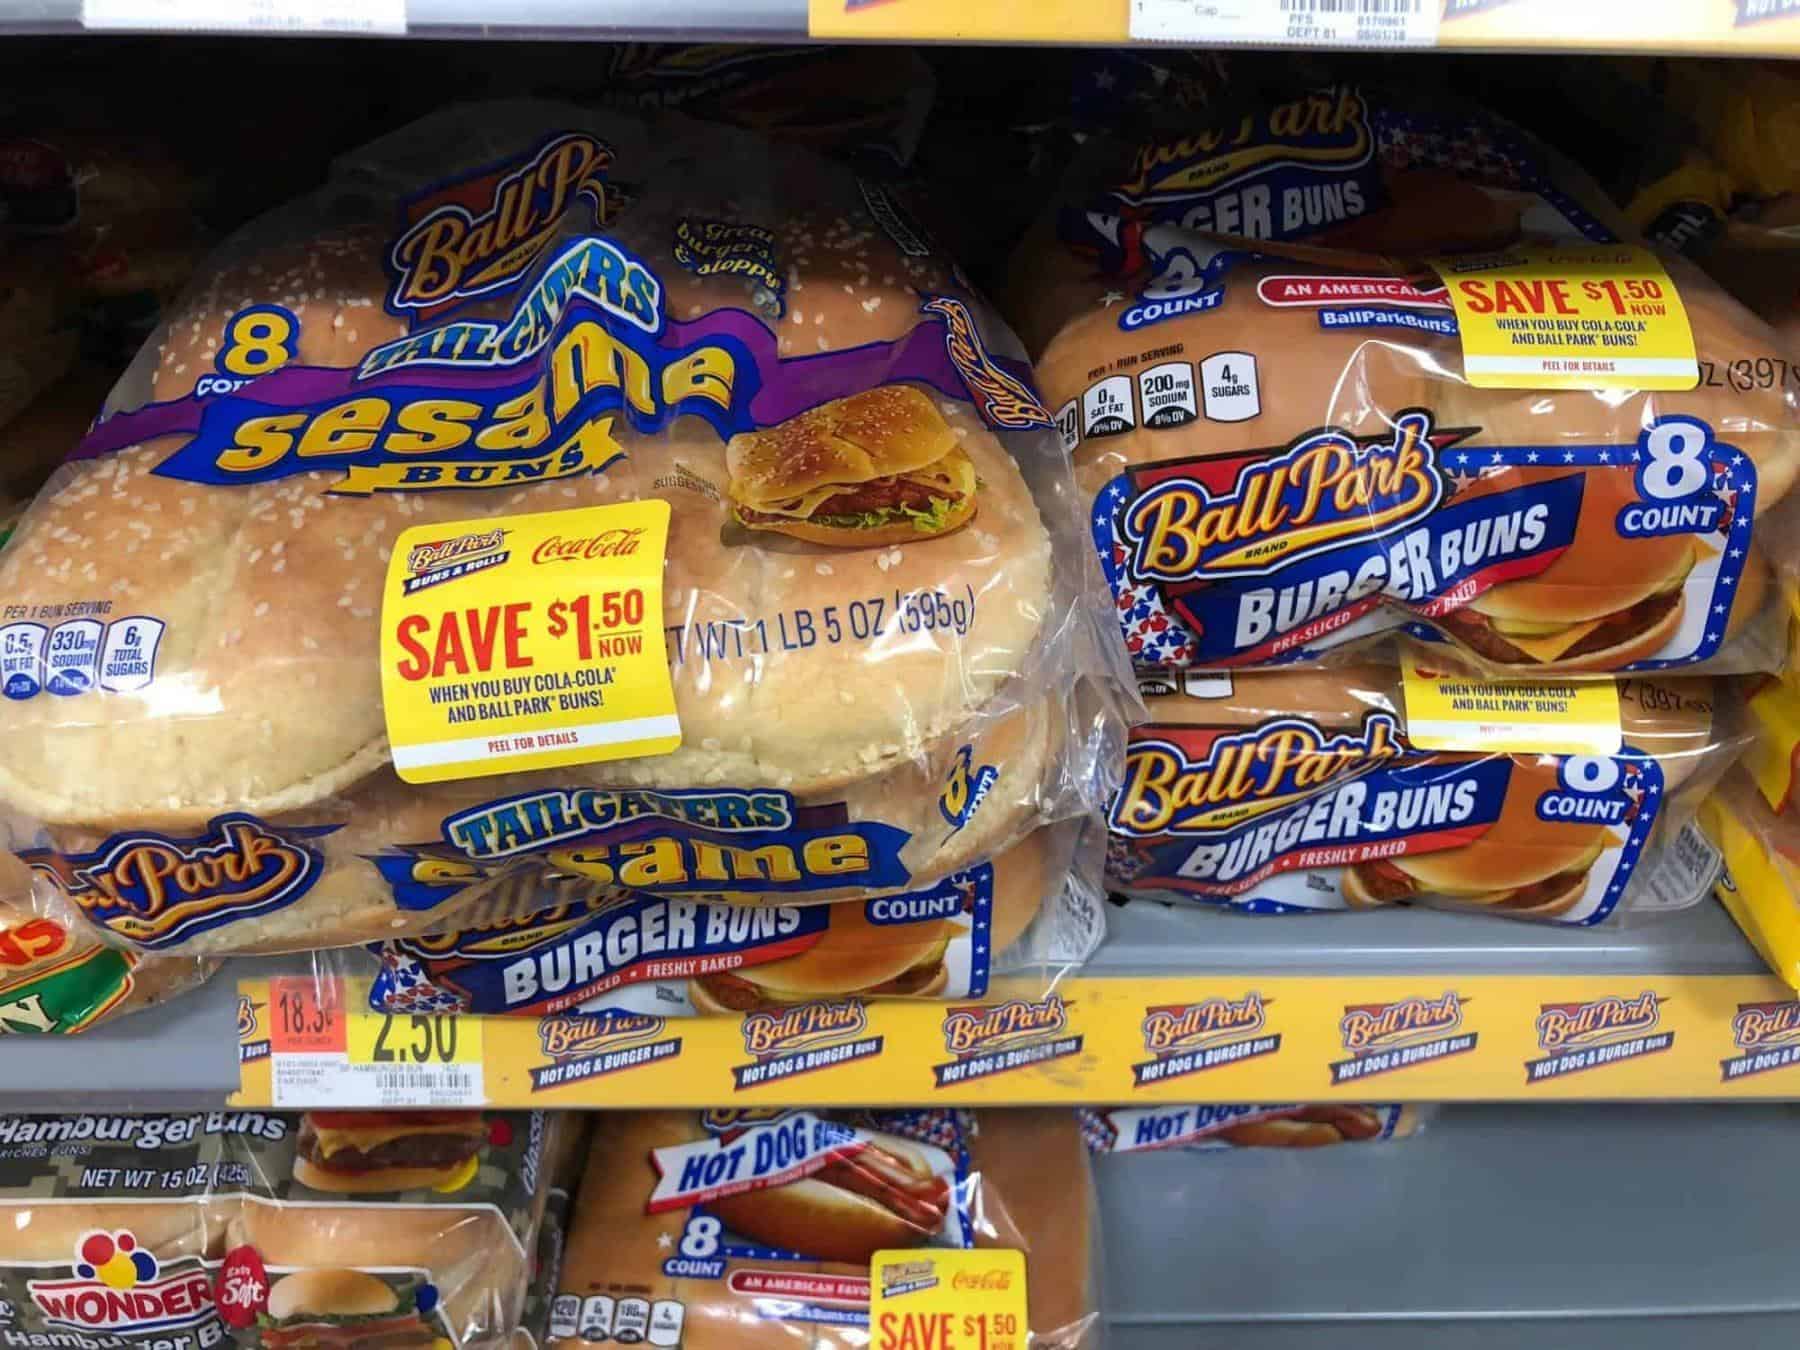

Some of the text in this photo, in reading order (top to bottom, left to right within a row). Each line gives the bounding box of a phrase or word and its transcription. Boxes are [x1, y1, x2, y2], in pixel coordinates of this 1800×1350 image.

[1283, 180, 1366, 232] BUNS
[403, 171, 540, 299] Ball
[697, 258, 783, 289] sloppy
[1284, 284, 1311, 296] AN
[1125, 291, 1220, 327] COUNT
[1459, 279, 1664, 316] SAVE $1.50
[1630, 304, 1667, 317] NOW
[1496, 318, 1530, 331] WHEN
[1531, 319, 1555, 331] YOU
[1557, 319, 1579, 332] BUY
[1511, 332, 1638, 347] AND BALL PARK BUNS!
[224, 313, 290, 375] 8
[1141, 343, 1184, 362] SERVING
[1221, 364, 1238, 384] 4g
[1542, 360, 1562, 371] PEEL
[1582, 361, 1616, 372] DETAILS
[216, 321, 735, 472] sesame
[1149, 391, 1188, 408] SODIUM
[1212, 384, 1250, 398] SUGARS
[1091, 403, 1124, 419] SAT FAT
[1111, 420, 1123, 431] DV
[400, 440, 585, 483] BUNS
[1643, 423, 1706, 499] 8
[1135, 424, 1434, 574] Ball Park
[1624, 505, 1718, 532] COUNT
[411, 529, 504, 572] Ball Park
[532, 528, 647, 565] Coca-Cola
[1245, 541, 1287, 560] BRAND
[410, 554, 506, 591] BUNS ROLLS
[1234, 503, 1549, 649] BURGER BUNS
[4, 600, 112, 618] PER BUN SERVING
[696, 583, 976, 661] WT 1 LB 5 OZ (595g)
[125, 626, 141, 647] 6g
[396, 588, 644, 682] SAVE $1.50
[599, 636, 643, 659] NOW
[1272, 610, 1351, 653] PRE-SLICED
[52, 653, 93, 667] SODIUM
[106, 662, 148, 676] SUGARS
[114, 649, 142, 661] TOTAL
[429, 668, 614, 705] WHEN YOU BUY COLA-COLA
[447, 690, 604, 724] AND BALL PARK BUNS!
[1453, 699, 1568, 713] AND BALL PARK BUNS!
[488, 731, 578, 753] PEEL FOR DETAILS
[1118, 743, 1255, 831] Ball
[456, 791, 787, 855] TAILGATERS
[1543, 796, 1625, 820] COUNT
[1177, 779, 1478, 881] BURGER BUNS
[114, 827, 297, 915] Park
[1299, 841, 1407, 867] FRESHLY BAKED
[872, 896, 960, 921] COUNT
[503, 901, 696, 1004] BURGER
[705, 904, 801, 945] BUNS
[547, 955, 743, 1013] PRE-SLICED FRESHLY BAKED
[547, 1020, 603, 1051] Ball
[749, 1003, 861, 1050] Ball Park
[951, 998, 1060, 1050] Ball Park
[1149, 997, 1259, 1050] Ball Park
[1347, 994, 1458, 1047] Ball Park
[1542, 993, 1655, 1046] Ball Park
[1740, 1008, 1789, 1045] Ball
[373, 1014, 457, 1063] 2.50
[540, 1047, 651, 1085] HOT DOG BURGER
[743, 1047, 854, 1083] HOT DOG BURGER
[943, 1045, 1054, 1082] HOT DOG BURGER
[1142, 1045, 1252, 1081] HOT DOG BURGER
[1340, 1042, 1447, 1079] HOT DOG BURGER
[1535, 1042, 1644, 1078] HOT DOG BURGER
[1730, 1053, 1779, 1076] HOT DOG
[0, 1113, 202, 1149] Hamburger
[1136, 1110, 1188, 1144] HOT
[678, 1146, 746, 1192] HOT
[753, 1116, 806, 1175] DOG
[81, 1166, 208, 1188] NET WT 15 OZ
[680, 1216, 721, 1257] 8
[665, 1259, 722, 1277] COUNT
[744, 1278, 834, 1292] AN AMERICAN
[36, 1279, 212, 1324] WONDER
[222, 1277, 264, 1307] Soft
[880, 1313, 954, 1350] SAVE
